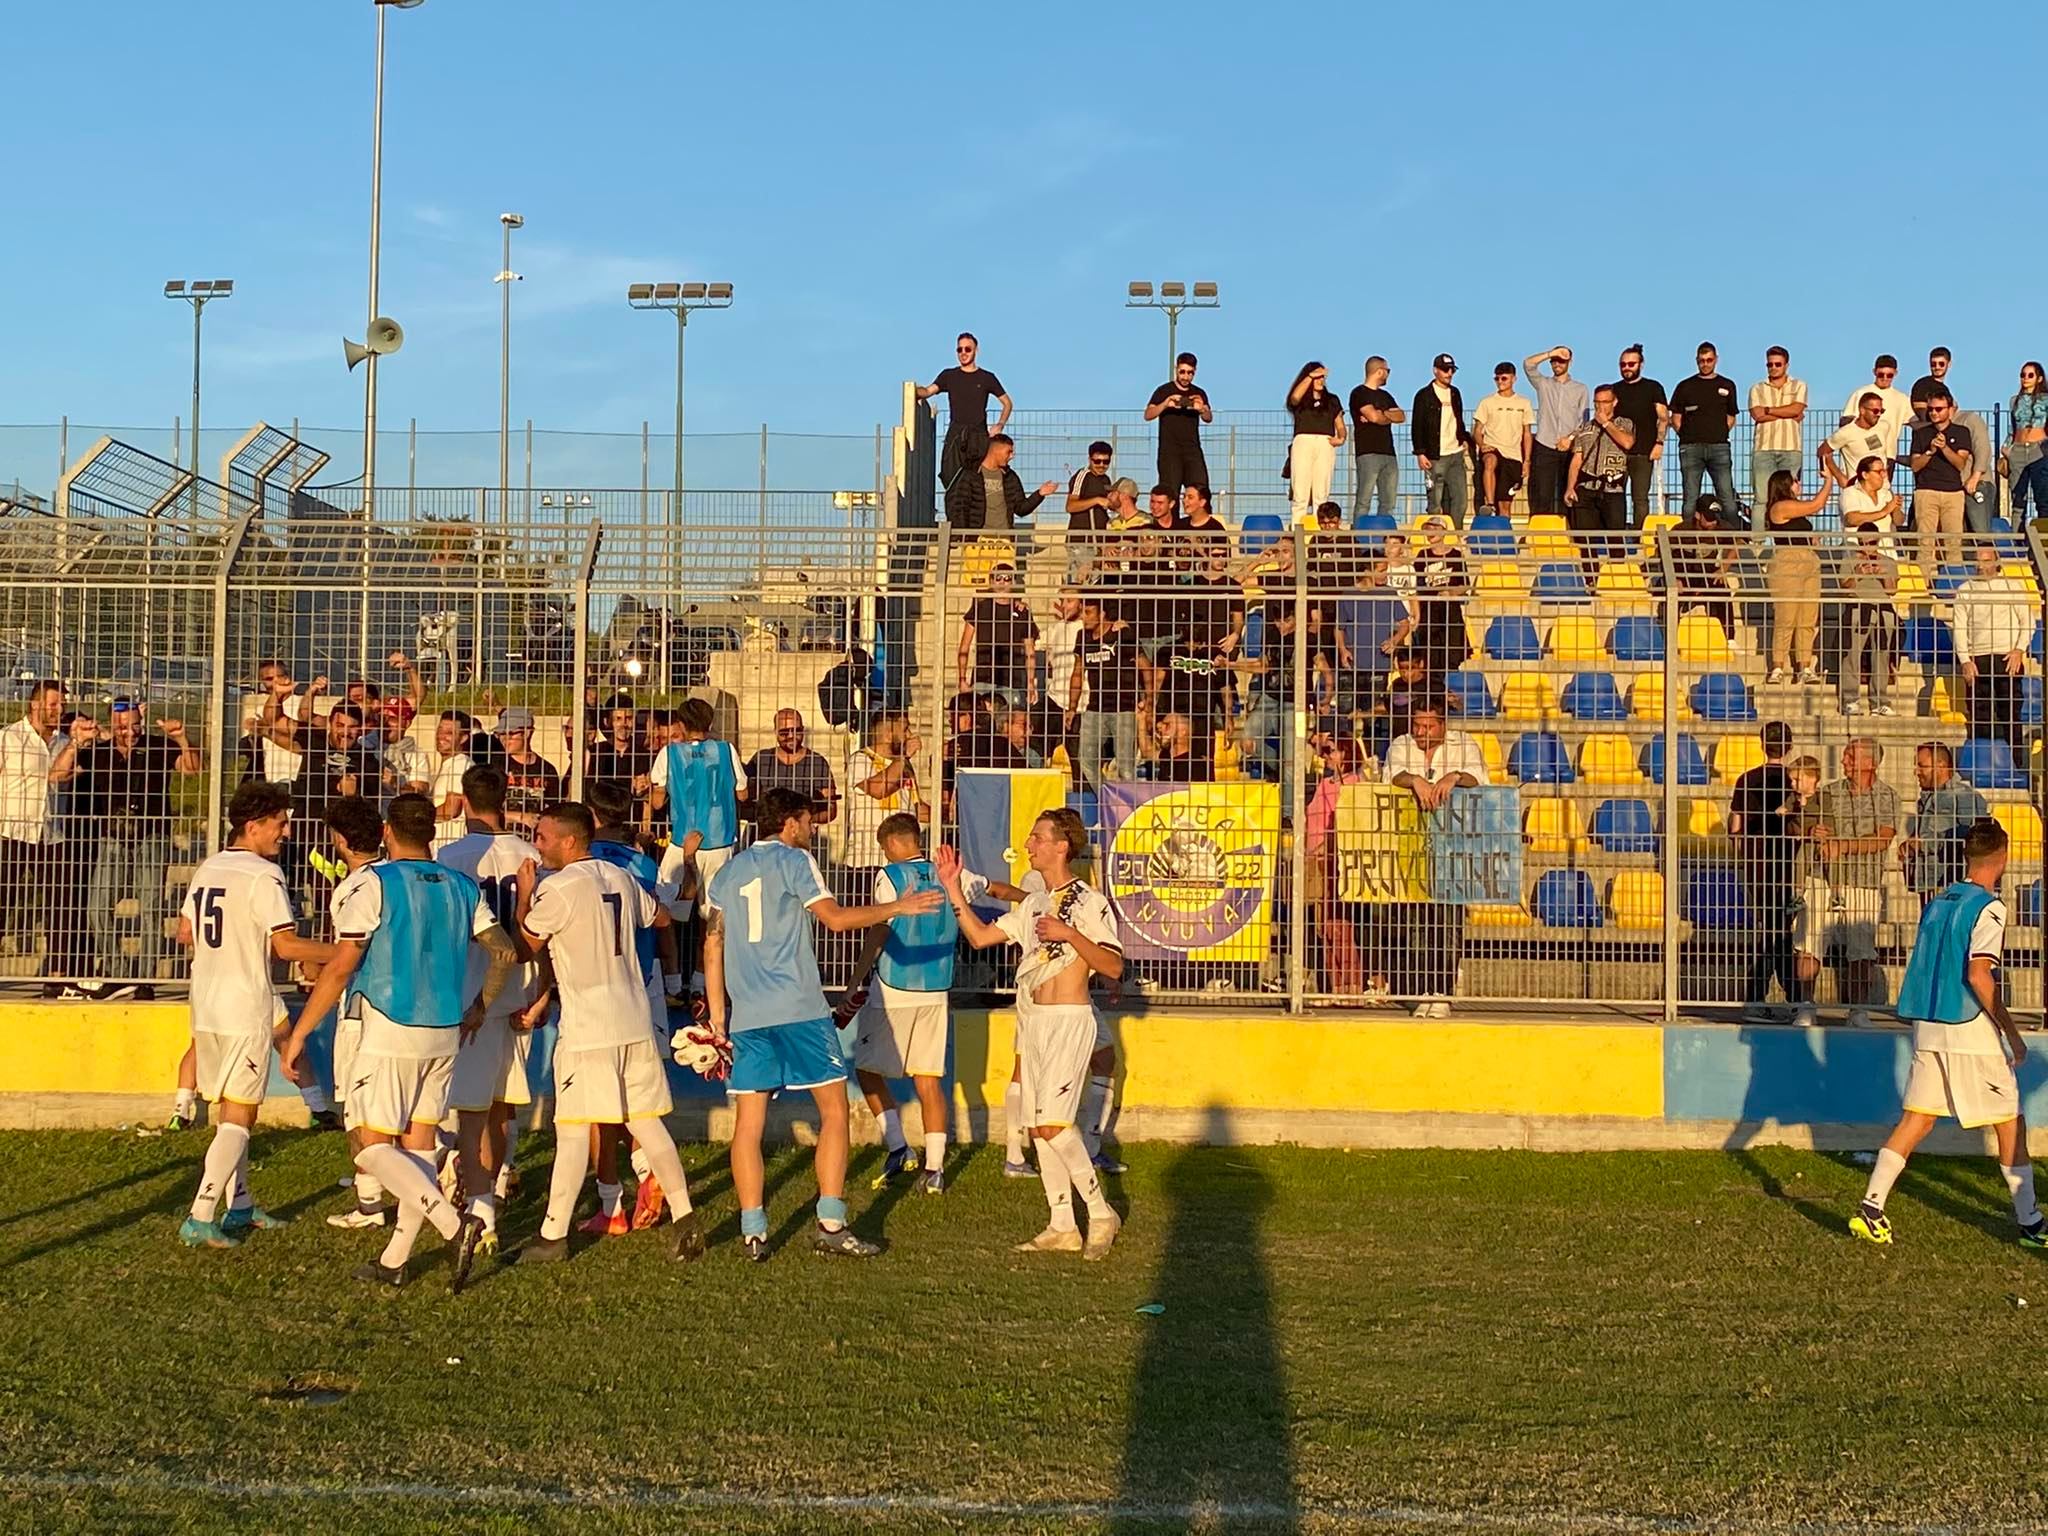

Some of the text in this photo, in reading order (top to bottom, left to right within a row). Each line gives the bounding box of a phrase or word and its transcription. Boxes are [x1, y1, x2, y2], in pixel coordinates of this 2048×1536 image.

[192, 886, 226, 948] 15
[601, 892, 622, 956] 7
[739, 877, 763, 943] 1
